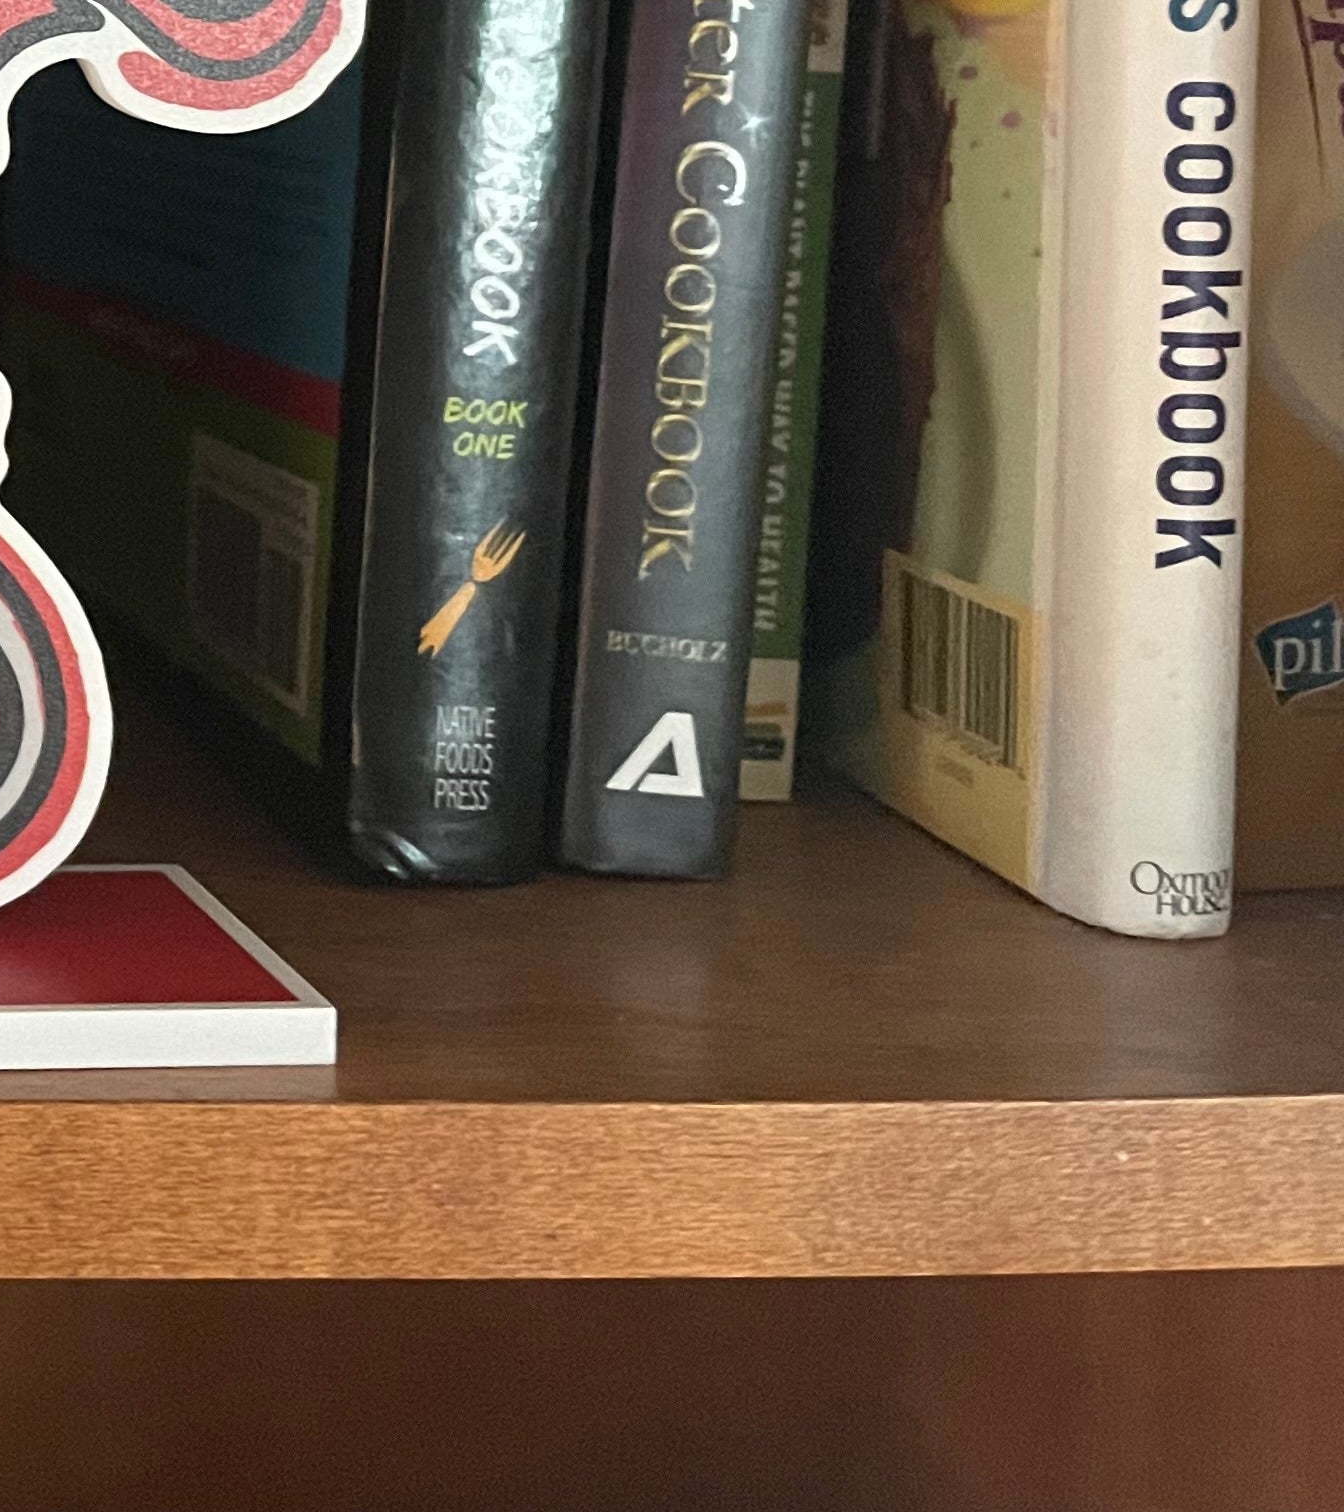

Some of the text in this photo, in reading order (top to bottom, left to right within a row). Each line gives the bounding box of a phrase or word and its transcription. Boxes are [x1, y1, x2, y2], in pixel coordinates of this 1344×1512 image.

[1154, 80, 1243, 570] cookbook
[442, 396, 528, 429] BOOK
[453, 431, 517, 459] ONE
[435, 705, 496, 739] NATIVE
[434, 742, 494, 774] FOODS
[433, 779, 491, 811] PRESS
